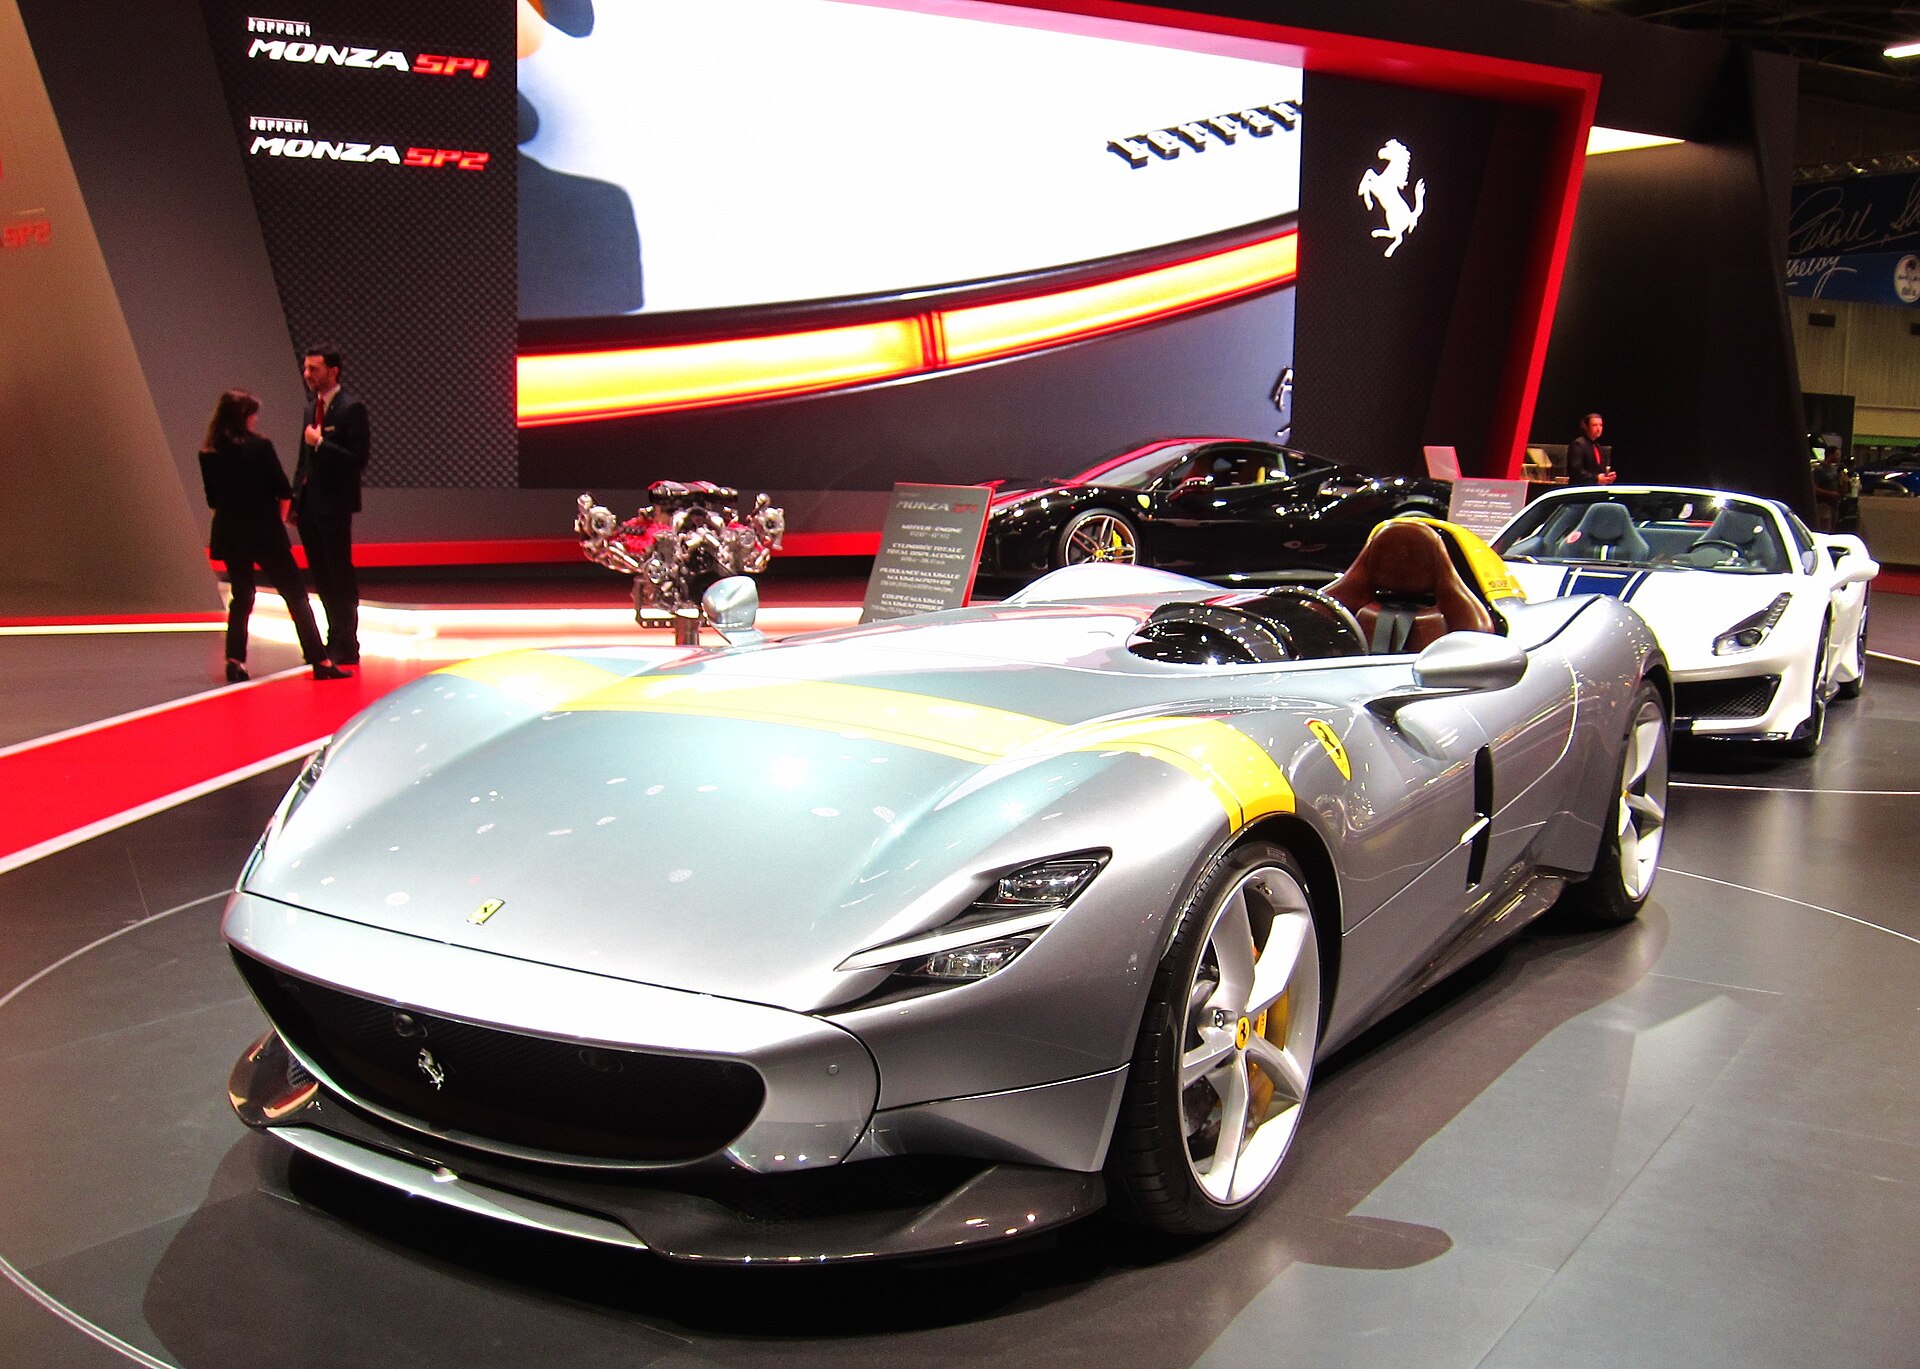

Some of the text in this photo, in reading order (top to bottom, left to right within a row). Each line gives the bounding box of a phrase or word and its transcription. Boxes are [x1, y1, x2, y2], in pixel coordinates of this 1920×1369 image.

[248, 38, 491, 79] MONZA SP1
[250, 136, 490, 171] MONZA SP2
[1106, 100, 1303, 170] Ferrar
